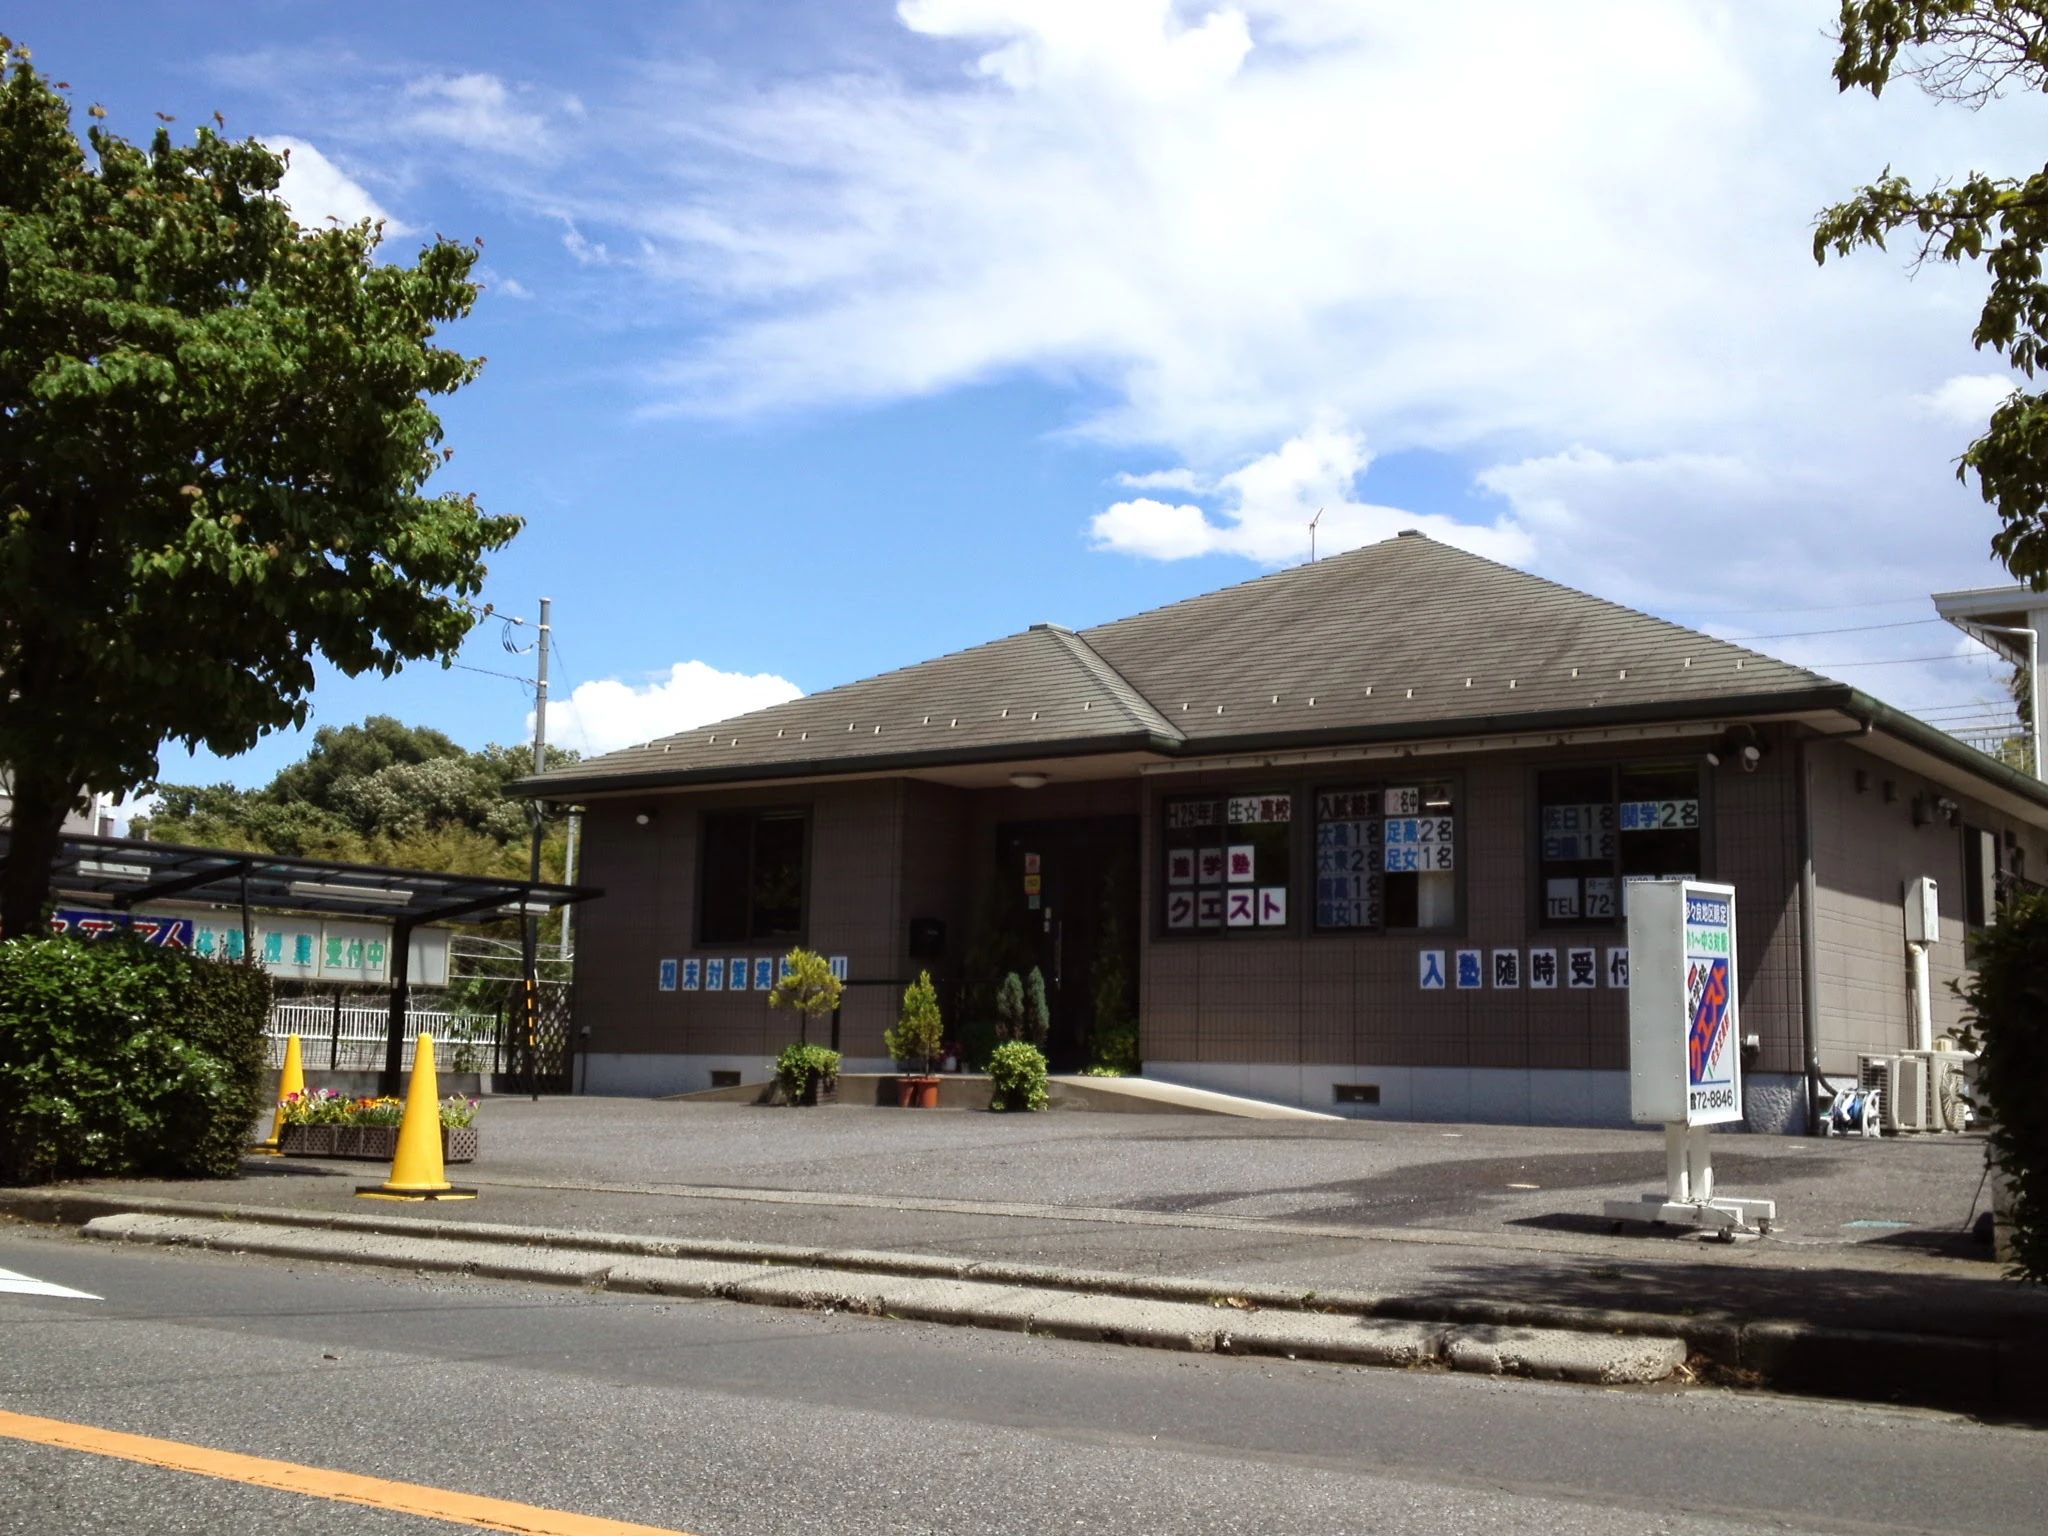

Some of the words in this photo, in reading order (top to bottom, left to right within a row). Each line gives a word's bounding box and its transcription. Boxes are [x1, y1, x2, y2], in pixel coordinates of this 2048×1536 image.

[1387, 846, 1452, 870] 足女1名
[1171, 893, 1280, 922] クエスト
[1549, 898, 1578, 915] TEL
